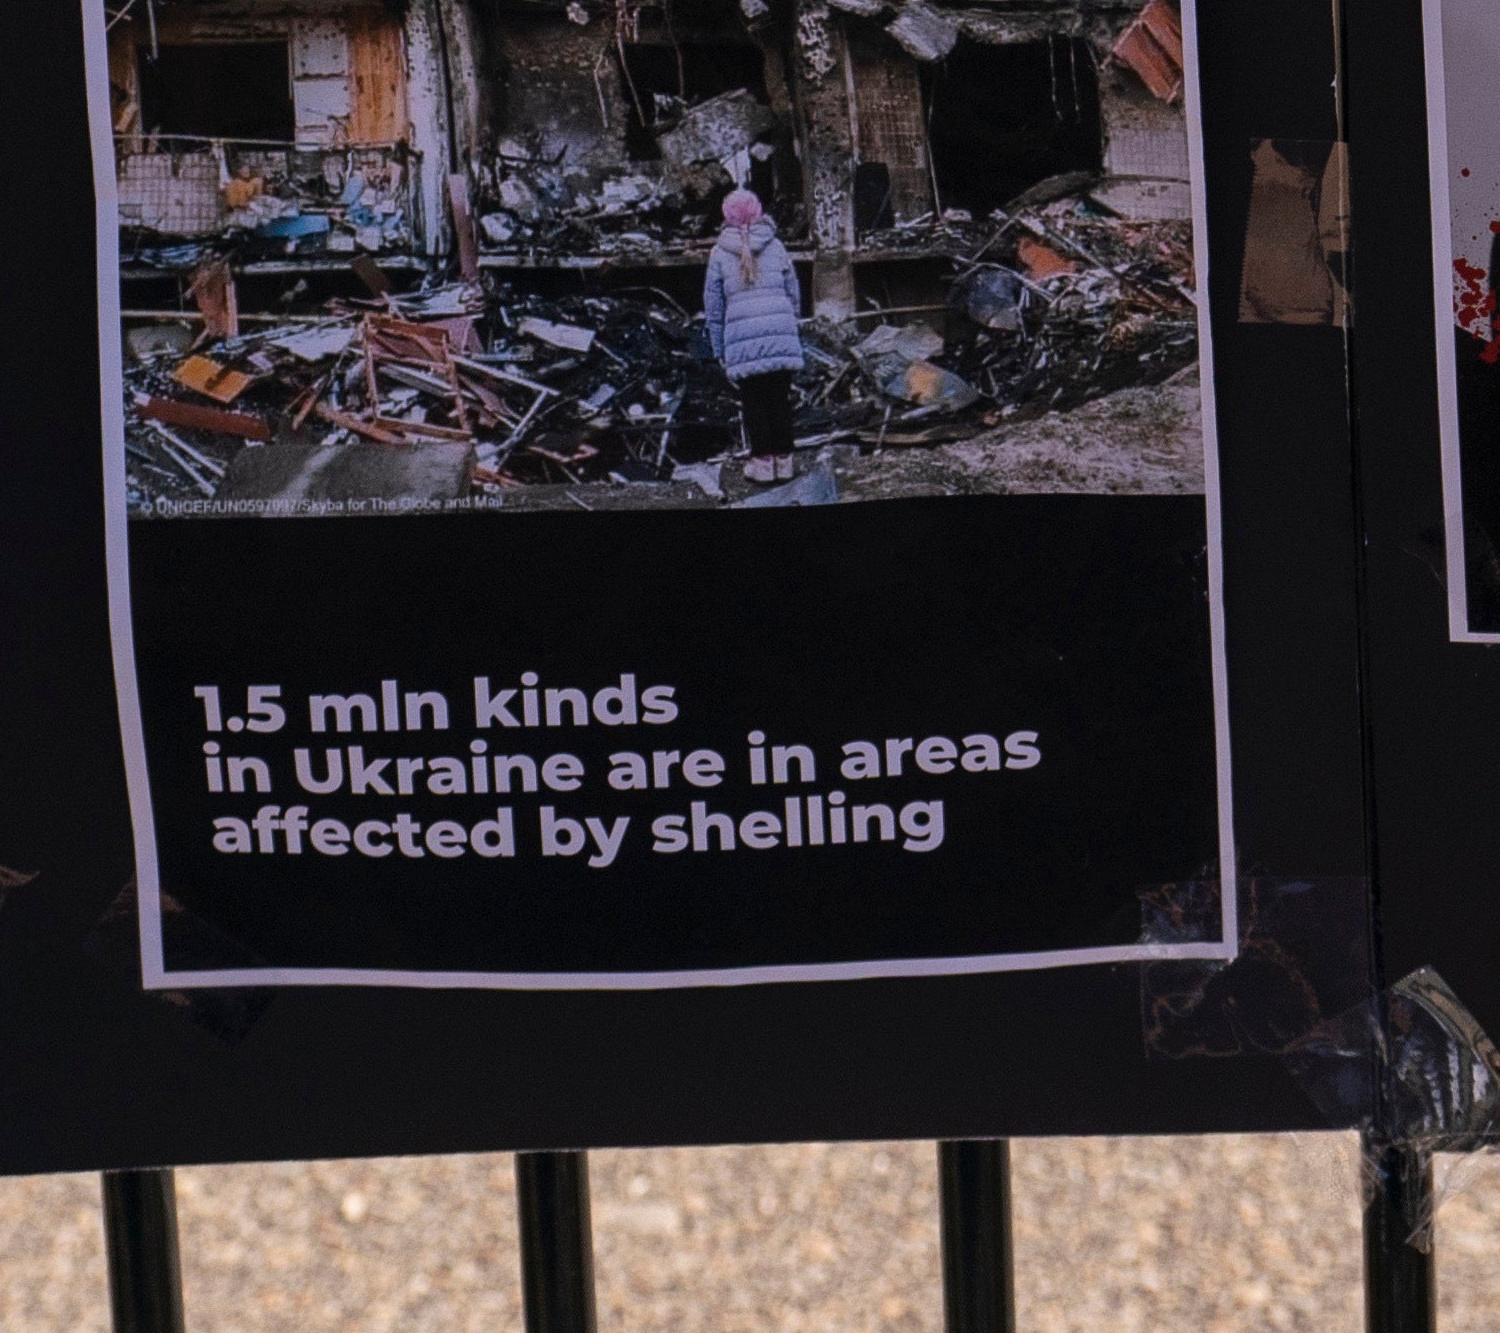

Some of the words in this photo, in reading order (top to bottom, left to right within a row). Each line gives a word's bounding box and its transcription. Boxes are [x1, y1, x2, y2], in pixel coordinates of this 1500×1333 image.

[347, 497, 367, 511] for
[370, 496, 398, 511] The
[194, 684, 287, 733] 1.5
[308, 679, 450, 733] mln
[473, 671, 680, 729] kinds
[202, 740, 273, 794] in
[293, 738, 586, 796] Ukraine
[606, 748, 726, 791] are
[746, 730, 818, 785] in
[839, 730, 1042, 781] areas
[211, 805, 516, 859] affected
[538, 805, 632, 868] by
[650, 789, 947, 853] shelling
